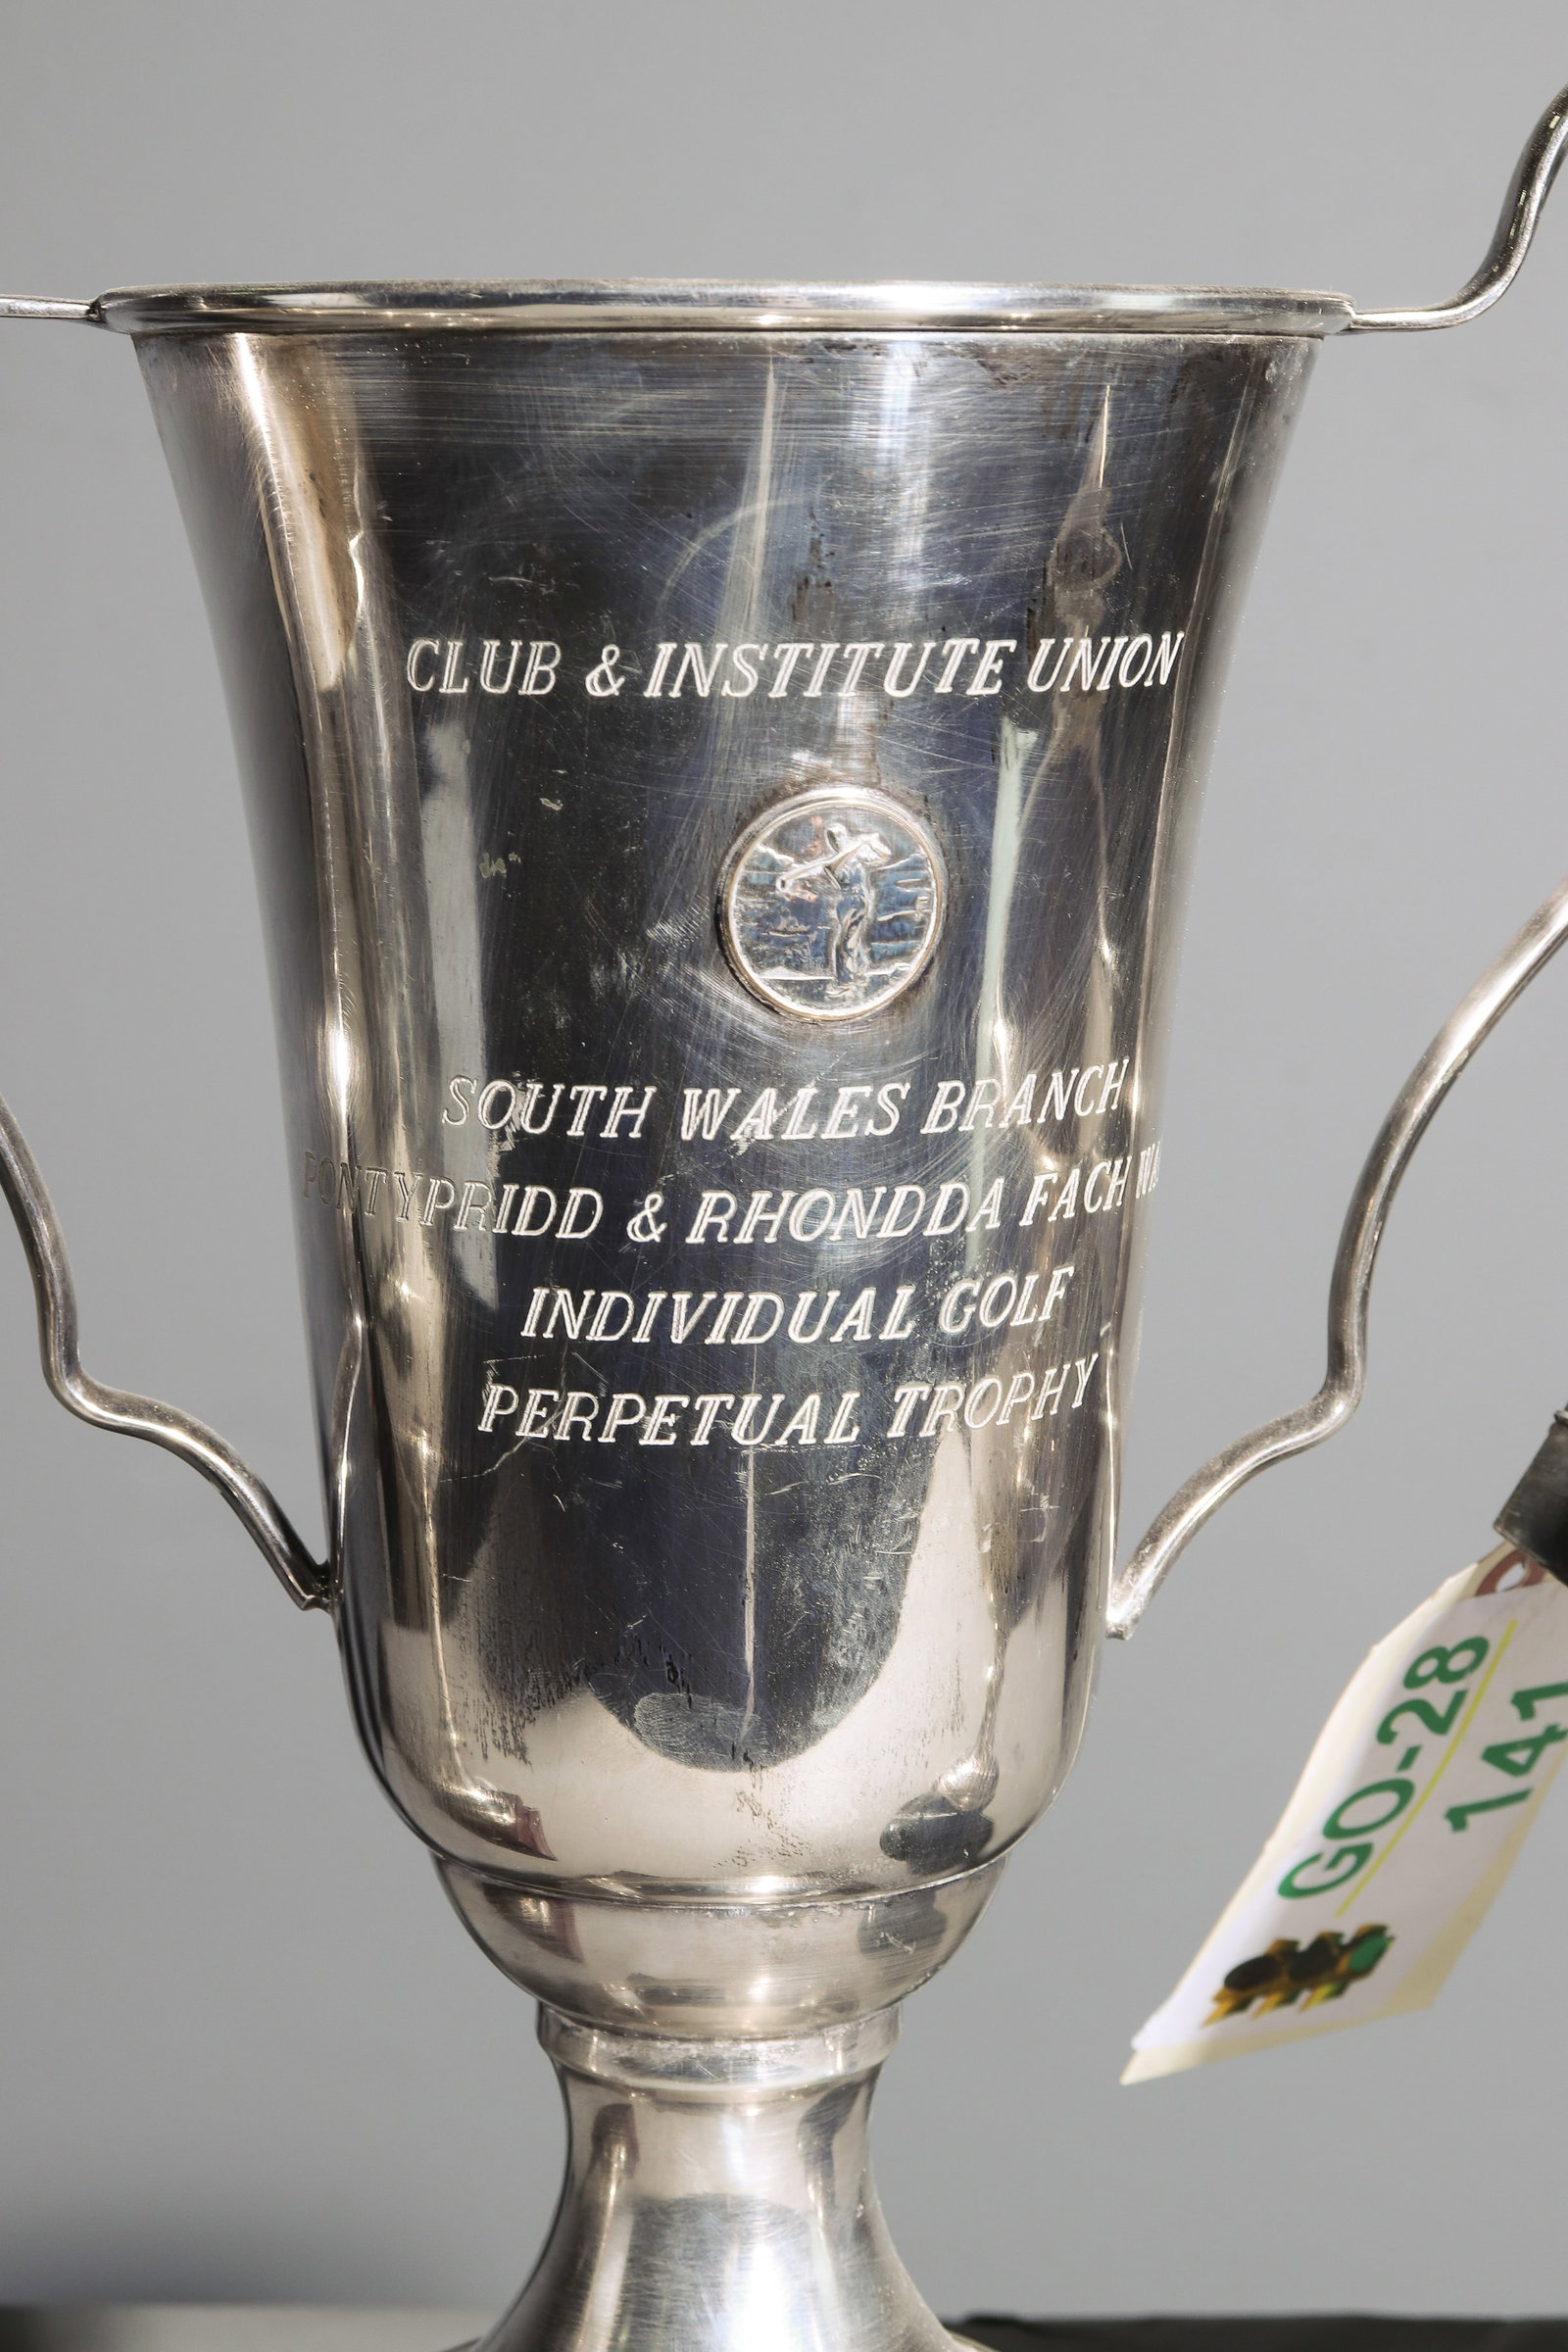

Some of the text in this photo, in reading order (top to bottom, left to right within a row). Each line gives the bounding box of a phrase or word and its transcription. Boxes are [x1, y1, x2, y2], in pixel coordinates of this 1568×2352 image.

[406, 630, 1185, 699] CLUB & INSTITUTE UNION
[441, 1057, 1130, 1141] SOUTH WALES BRANCH
[303, 1151, 604, 1240] PONTYPRIDD
[626, 1191, 667, 1243] &
[685, 1177, 1005, 1245] RHONDDA
[1019, 1155, 1133, 1227] FACH
[520, 1266, 1075, 1346] INDIVIDUAL GOLF
[477, 1351, 1100, 1446] PERPETUAL TROPHY
[1277, 1635, 1490, 1900] GO-28
